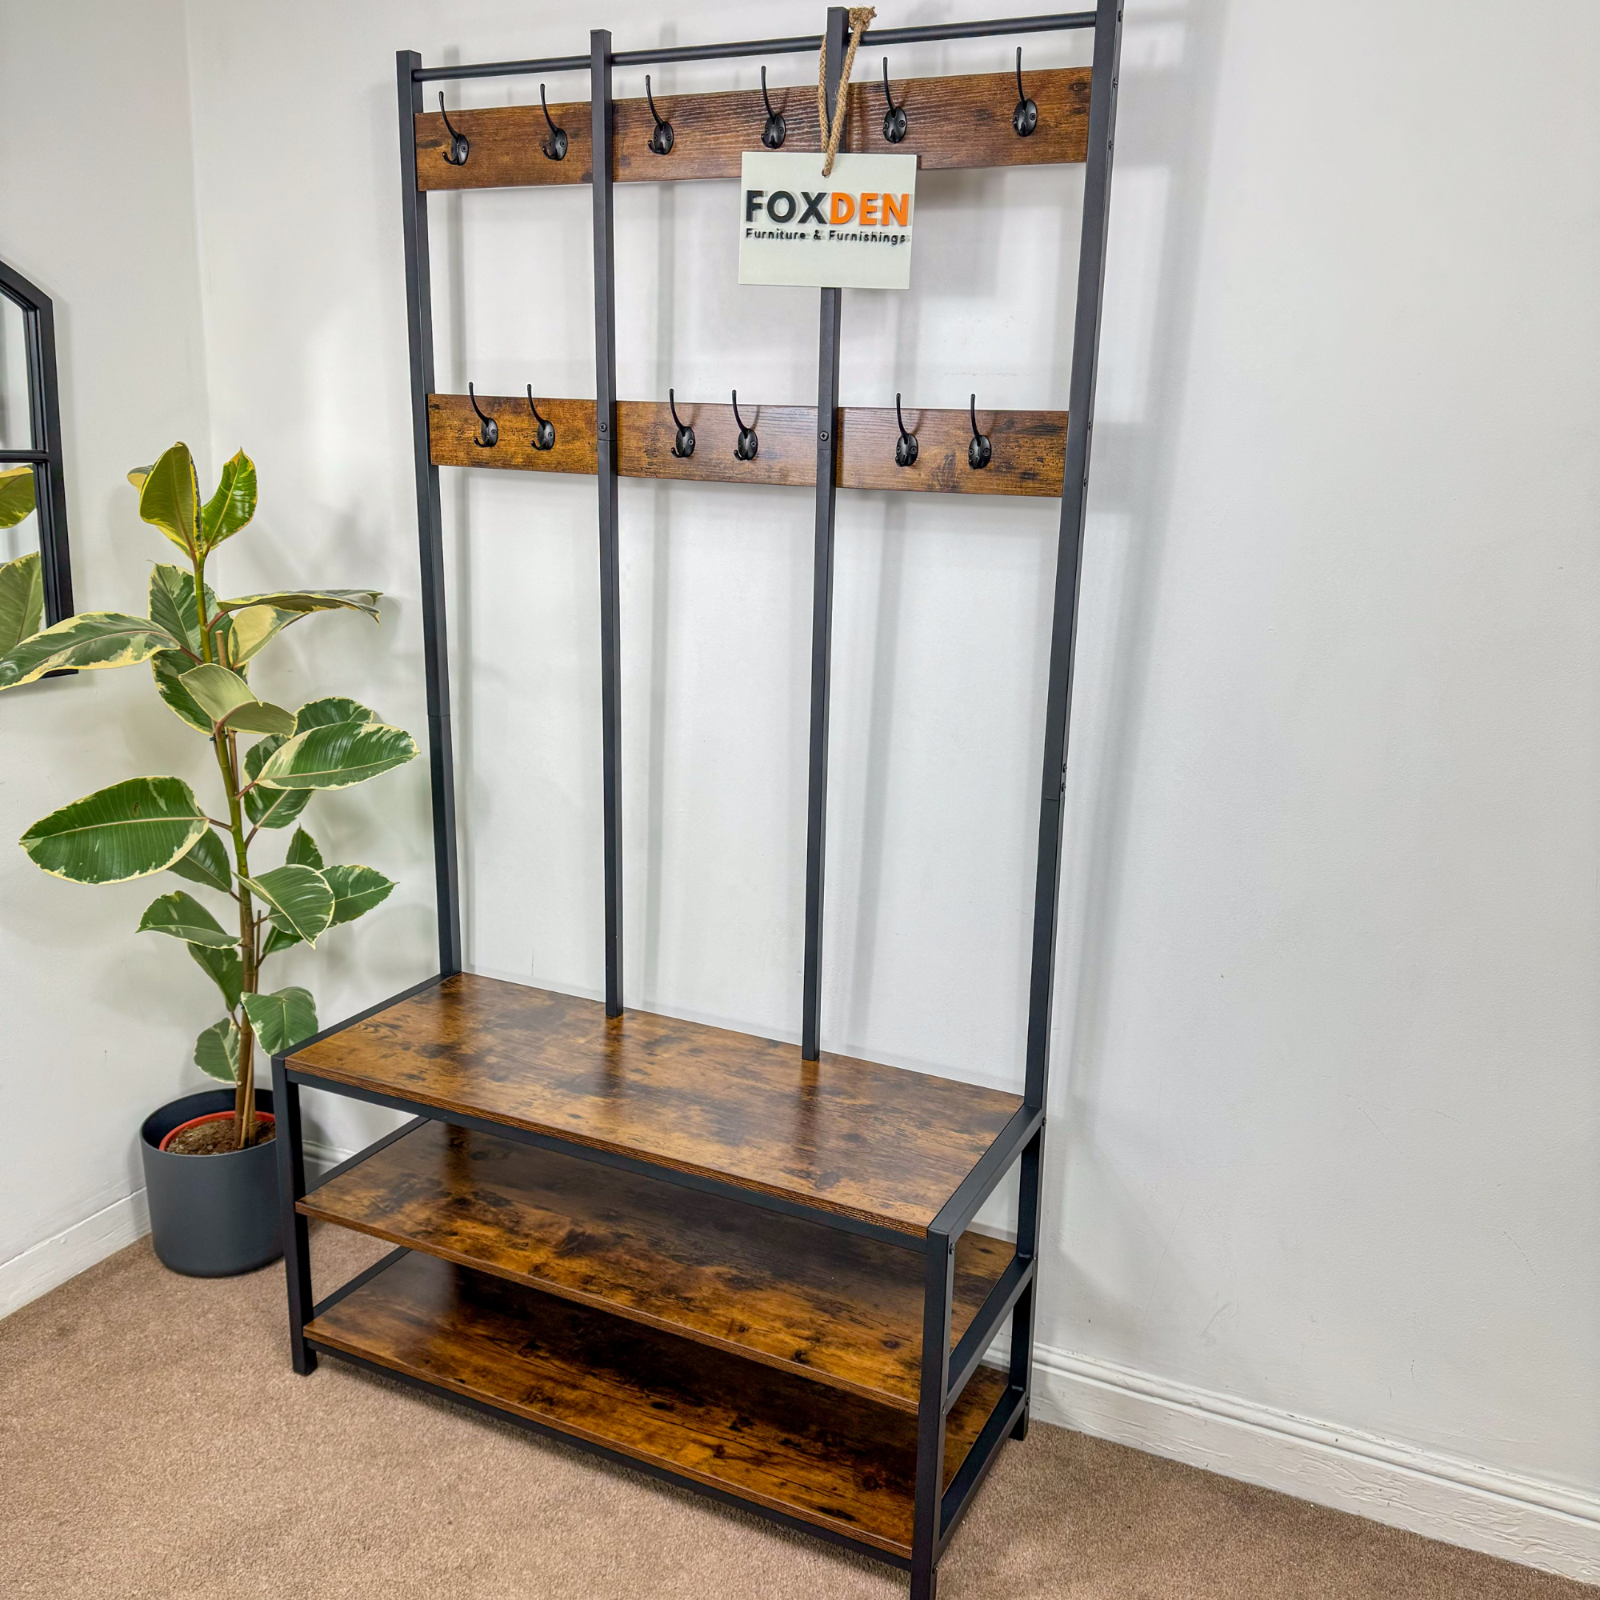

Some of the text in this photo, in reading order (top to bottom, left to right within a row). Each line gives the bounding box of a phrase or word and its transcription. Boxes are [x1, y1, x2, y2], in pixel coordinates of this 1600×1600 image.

[746, 190, 909, 226] FOXDEN
[746, 228, 906, 245] Furniture & Furnishings
